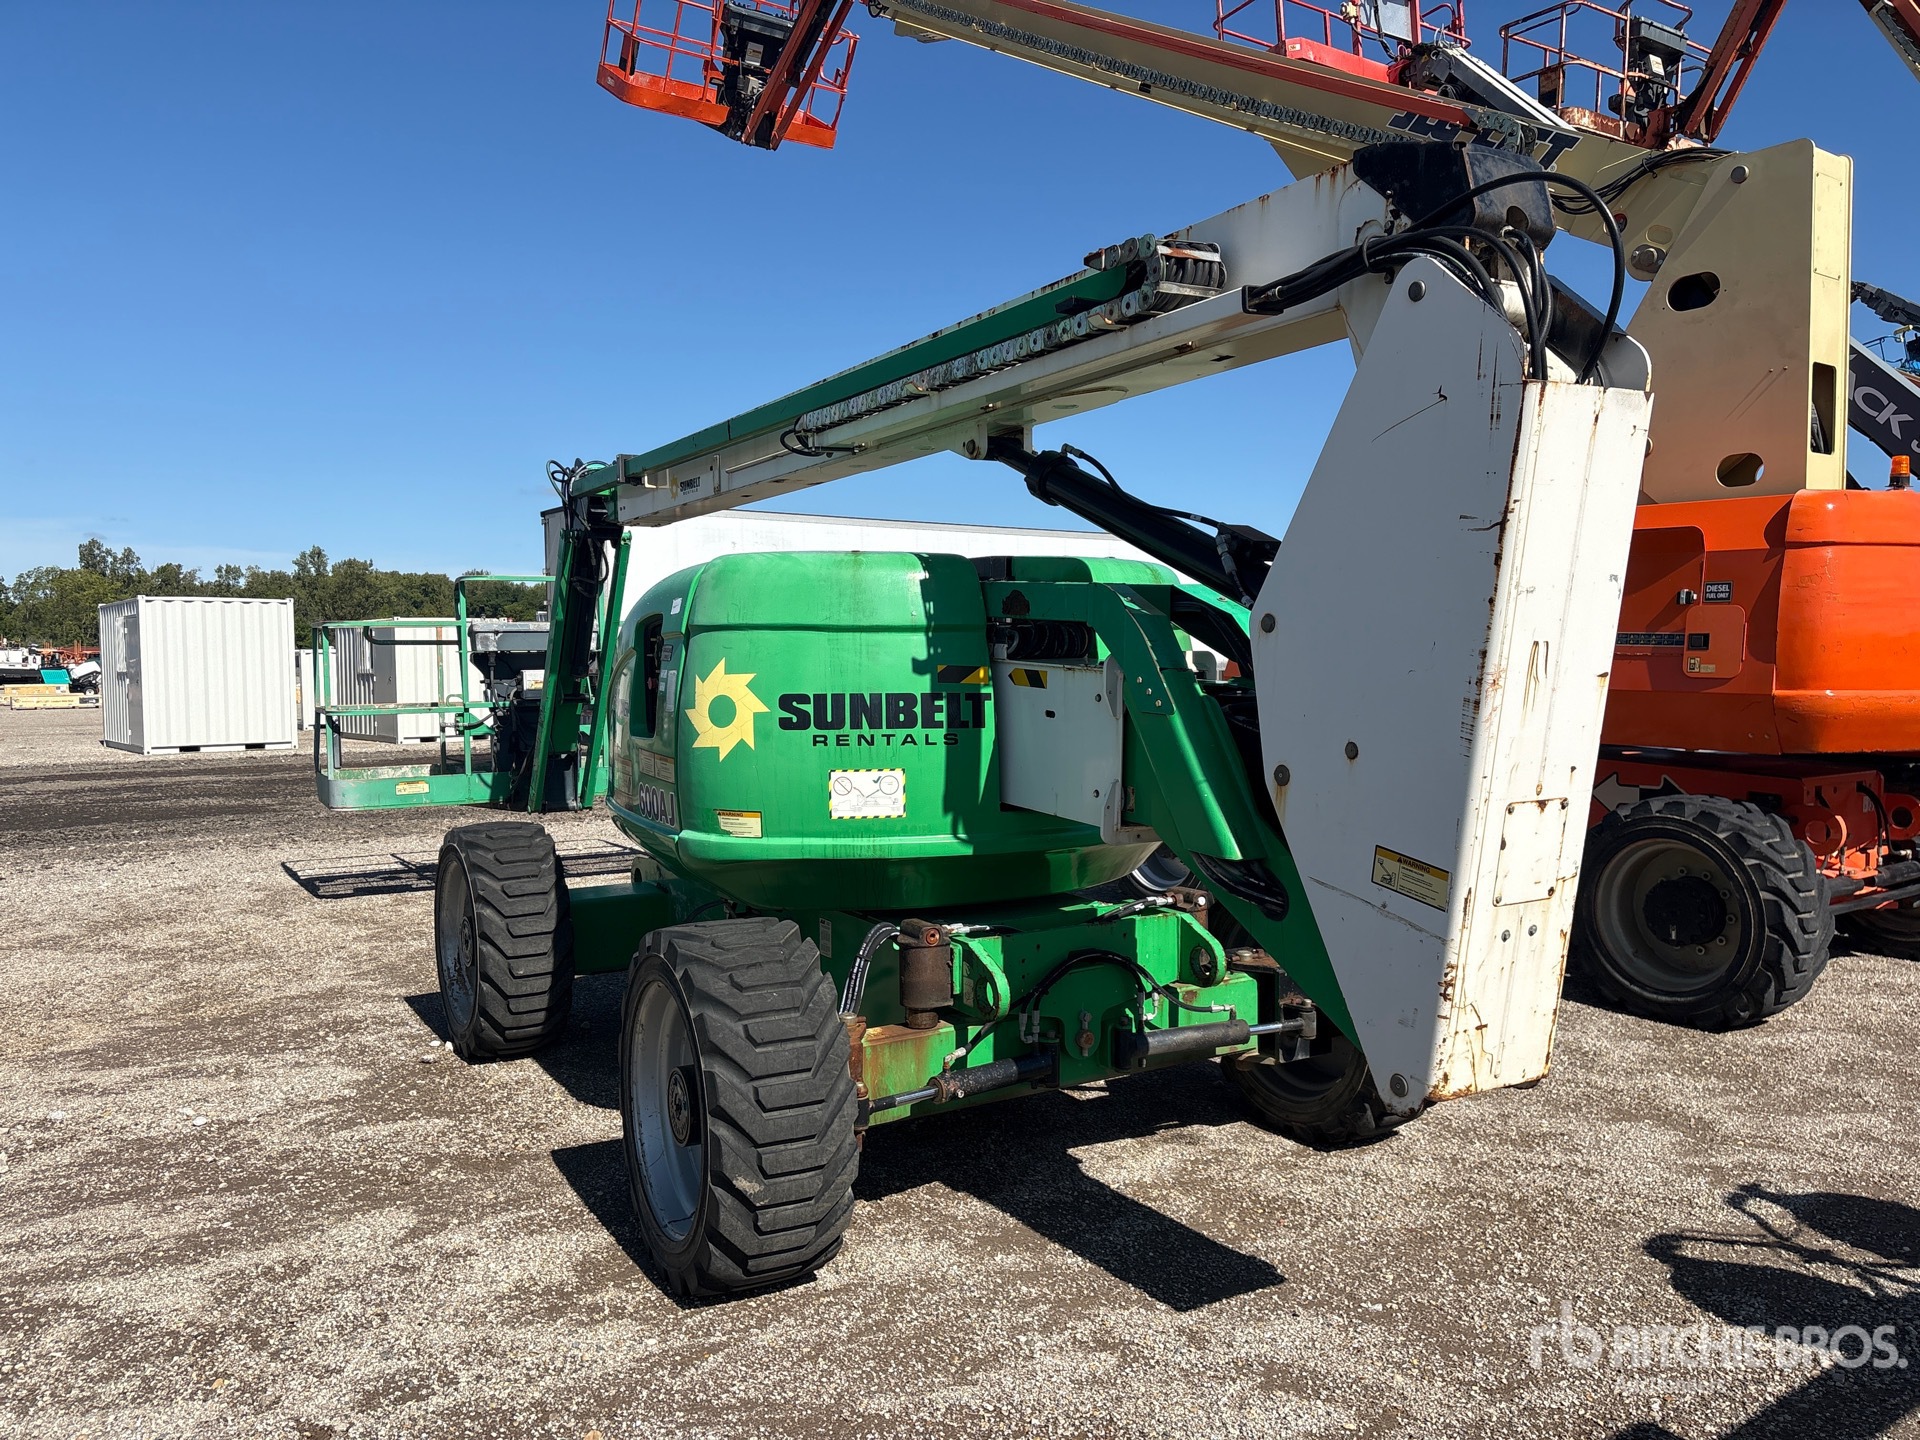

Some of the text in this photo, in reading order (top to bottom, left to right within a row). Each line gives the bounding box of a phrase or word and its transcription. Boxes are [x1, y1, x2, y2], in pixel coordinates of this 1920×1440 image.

[1706, 584, 1730, 592] DIESEL
[778, 692, 991, 731] SUNBELT
[812, 733, 960, 747] RENTALS
[638, 781, 676, 828] 600AJ
[1402, 858, 1430, 873] WARNING
